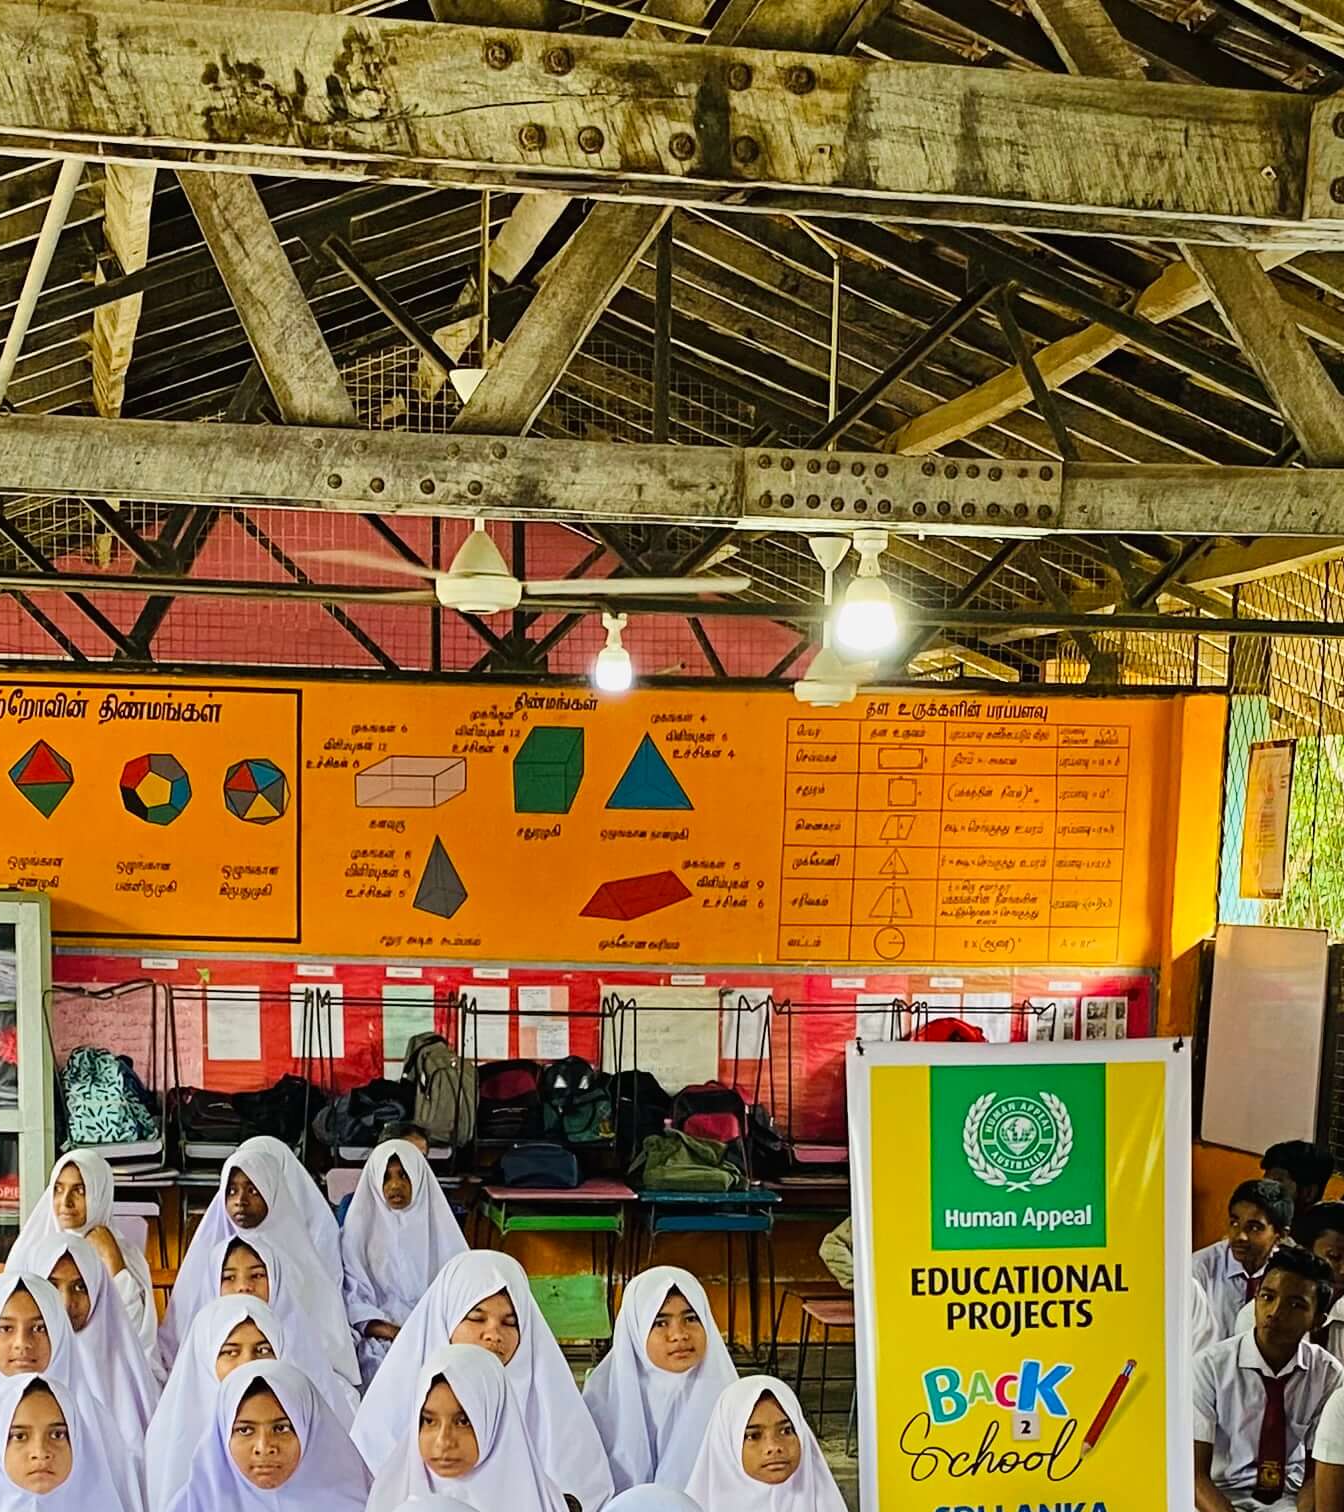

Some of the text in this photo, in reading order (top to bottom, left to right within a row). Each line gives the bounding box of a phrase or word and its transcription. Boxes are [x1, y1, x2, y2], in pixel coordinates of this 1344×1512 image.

[98, 691, 223, 724] திண்மங்கள்
[514, 692, 598, 713] திண்மங்கள்
[898, 700, 982, 720] உருக்களின்
[987, 700, 1049, 722] பரப்பளவு
[984, 1102, 1052, 1133] HUMAN APPEAL
[990, 1151, 1047, 1169] AUSTRALIA
[945, 1204, 1092, 1232] Human Appeal
[910, 1263, 1129, 1297] EDUCATIONAL
[946, 1299, 1093, 1338] PROJECTS
[922, 1358, 1075, 1426] BACK
[1021, 1419, 1032, 1434] 2
[899, 1412, 1083, 1482] School
